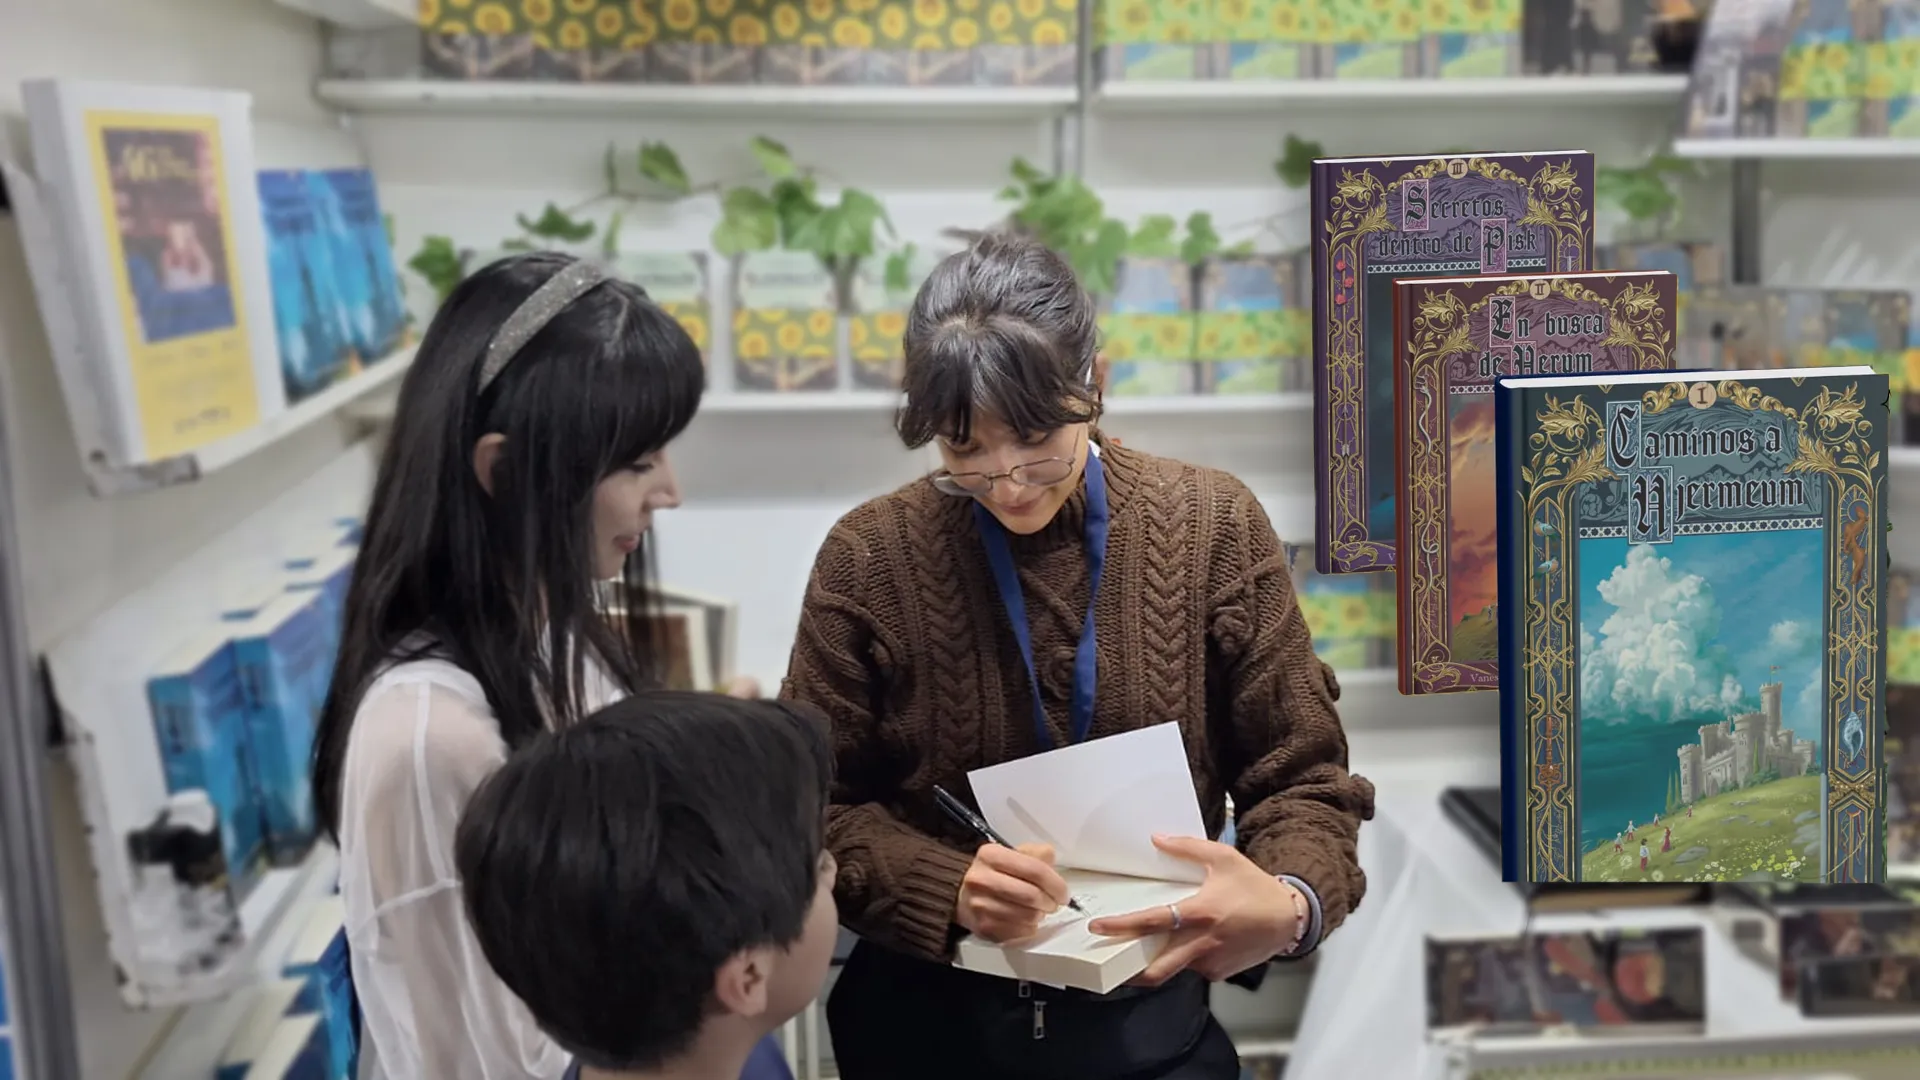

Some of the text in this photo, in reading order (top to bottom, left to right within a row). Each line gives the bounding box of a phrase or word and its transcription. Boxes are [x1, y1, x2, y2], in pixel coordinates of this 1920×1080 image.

[1452, 163, 1464, 175] III
[1405, 186, 1504, 225] Secretos
[1379, 225, 1536, 266] dentro de Pisk
[1535, 283, 1545, 296] II
[1491, 299, 1604, 340] En busca
[1480, 350, 1503, 377] de
[1697, 386, 1708, 404] I
[1610, 404, 1783, 470] Caminos a
